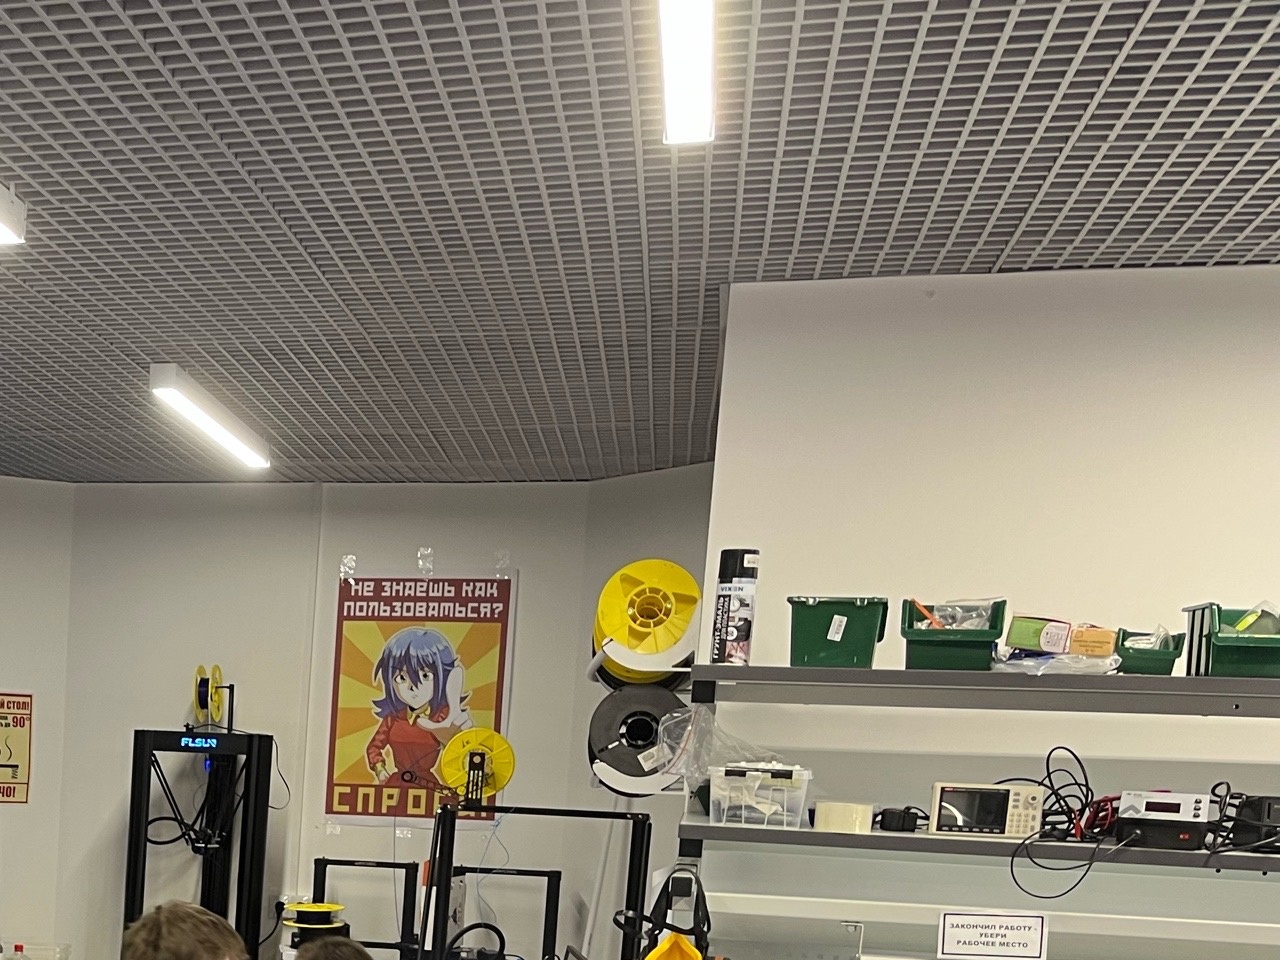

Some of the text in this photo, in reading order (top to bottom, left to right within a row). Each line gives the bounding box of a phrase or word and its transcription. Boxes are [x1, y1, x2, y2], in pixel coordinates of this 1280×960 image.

[351, 581, 498, 597] НЕ ЗНАЕШЬ КАК
[343, 601, 503, 618] ПОЛЬЗОВАТЬСЯ?
[7, 701, 29, 710] СТОЛ!
[949, 923, 996, 931] ЗАКОНЧИЛ
[956, 940, 996, 948] РАБОЧЕЕ
